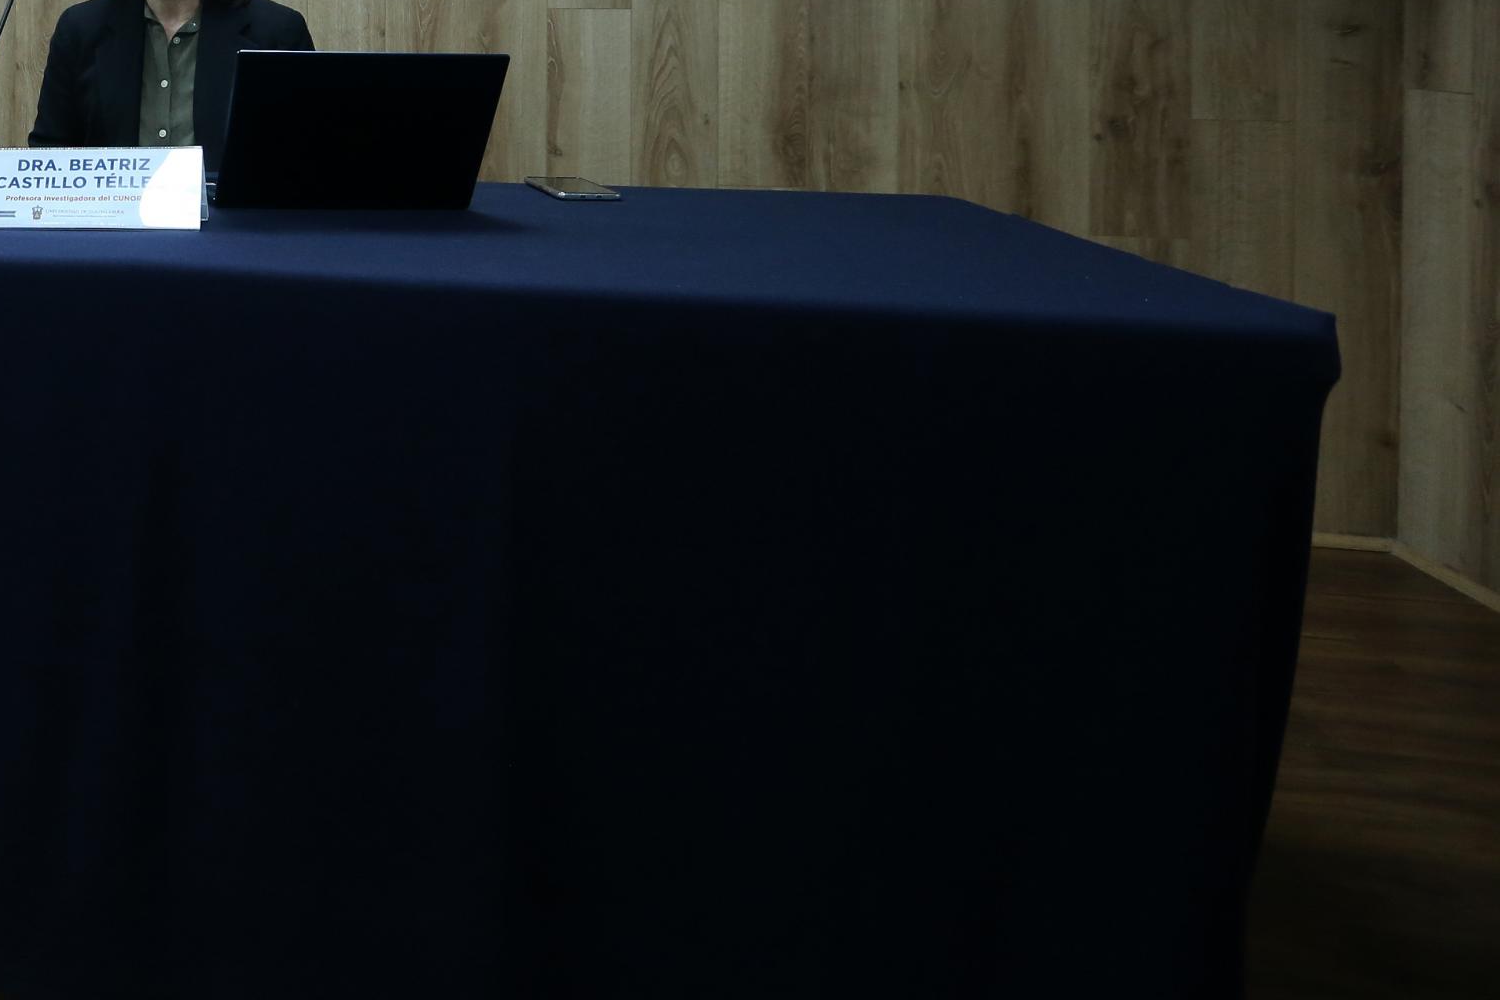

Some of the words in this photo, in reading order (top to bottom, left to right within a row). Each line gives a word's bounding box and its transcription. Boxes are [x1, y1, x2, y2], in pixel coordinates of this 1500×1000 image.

[17, 158, 62, 171] DRA.
[69, 158, 150, 171] BEATRIZ
[94, 172, 152, 188] TÉLLE
[5, 194, 41, 202] Profesora
[43, 194, 97, 203] Investigadora
[100, 194, 111, 202] del
